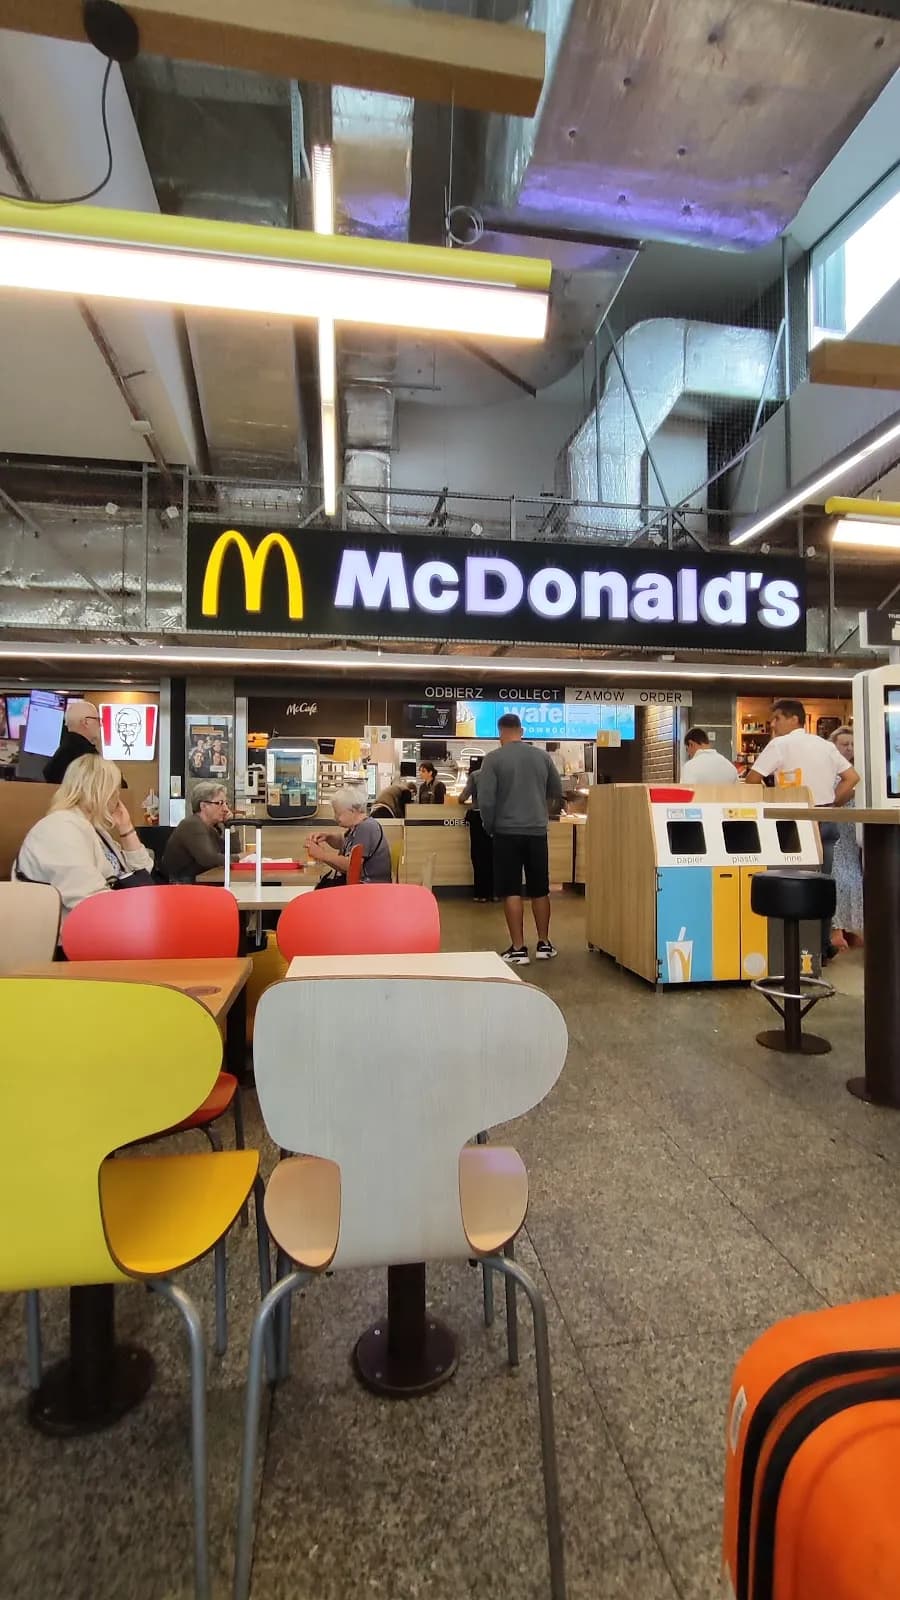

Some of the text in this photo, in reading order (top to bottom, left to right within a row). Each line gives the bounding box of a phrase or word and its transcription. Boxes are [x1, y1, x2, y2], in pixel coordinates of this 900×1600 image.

[334, 549, 800, 628] McDonald's
[424, 686, 560, 701] ODBIERZ COLLECT
[640, 692, 682, 703] ORDER
[676, 855, 703, 864] papier
[732, 854, 759, 864] plastik
